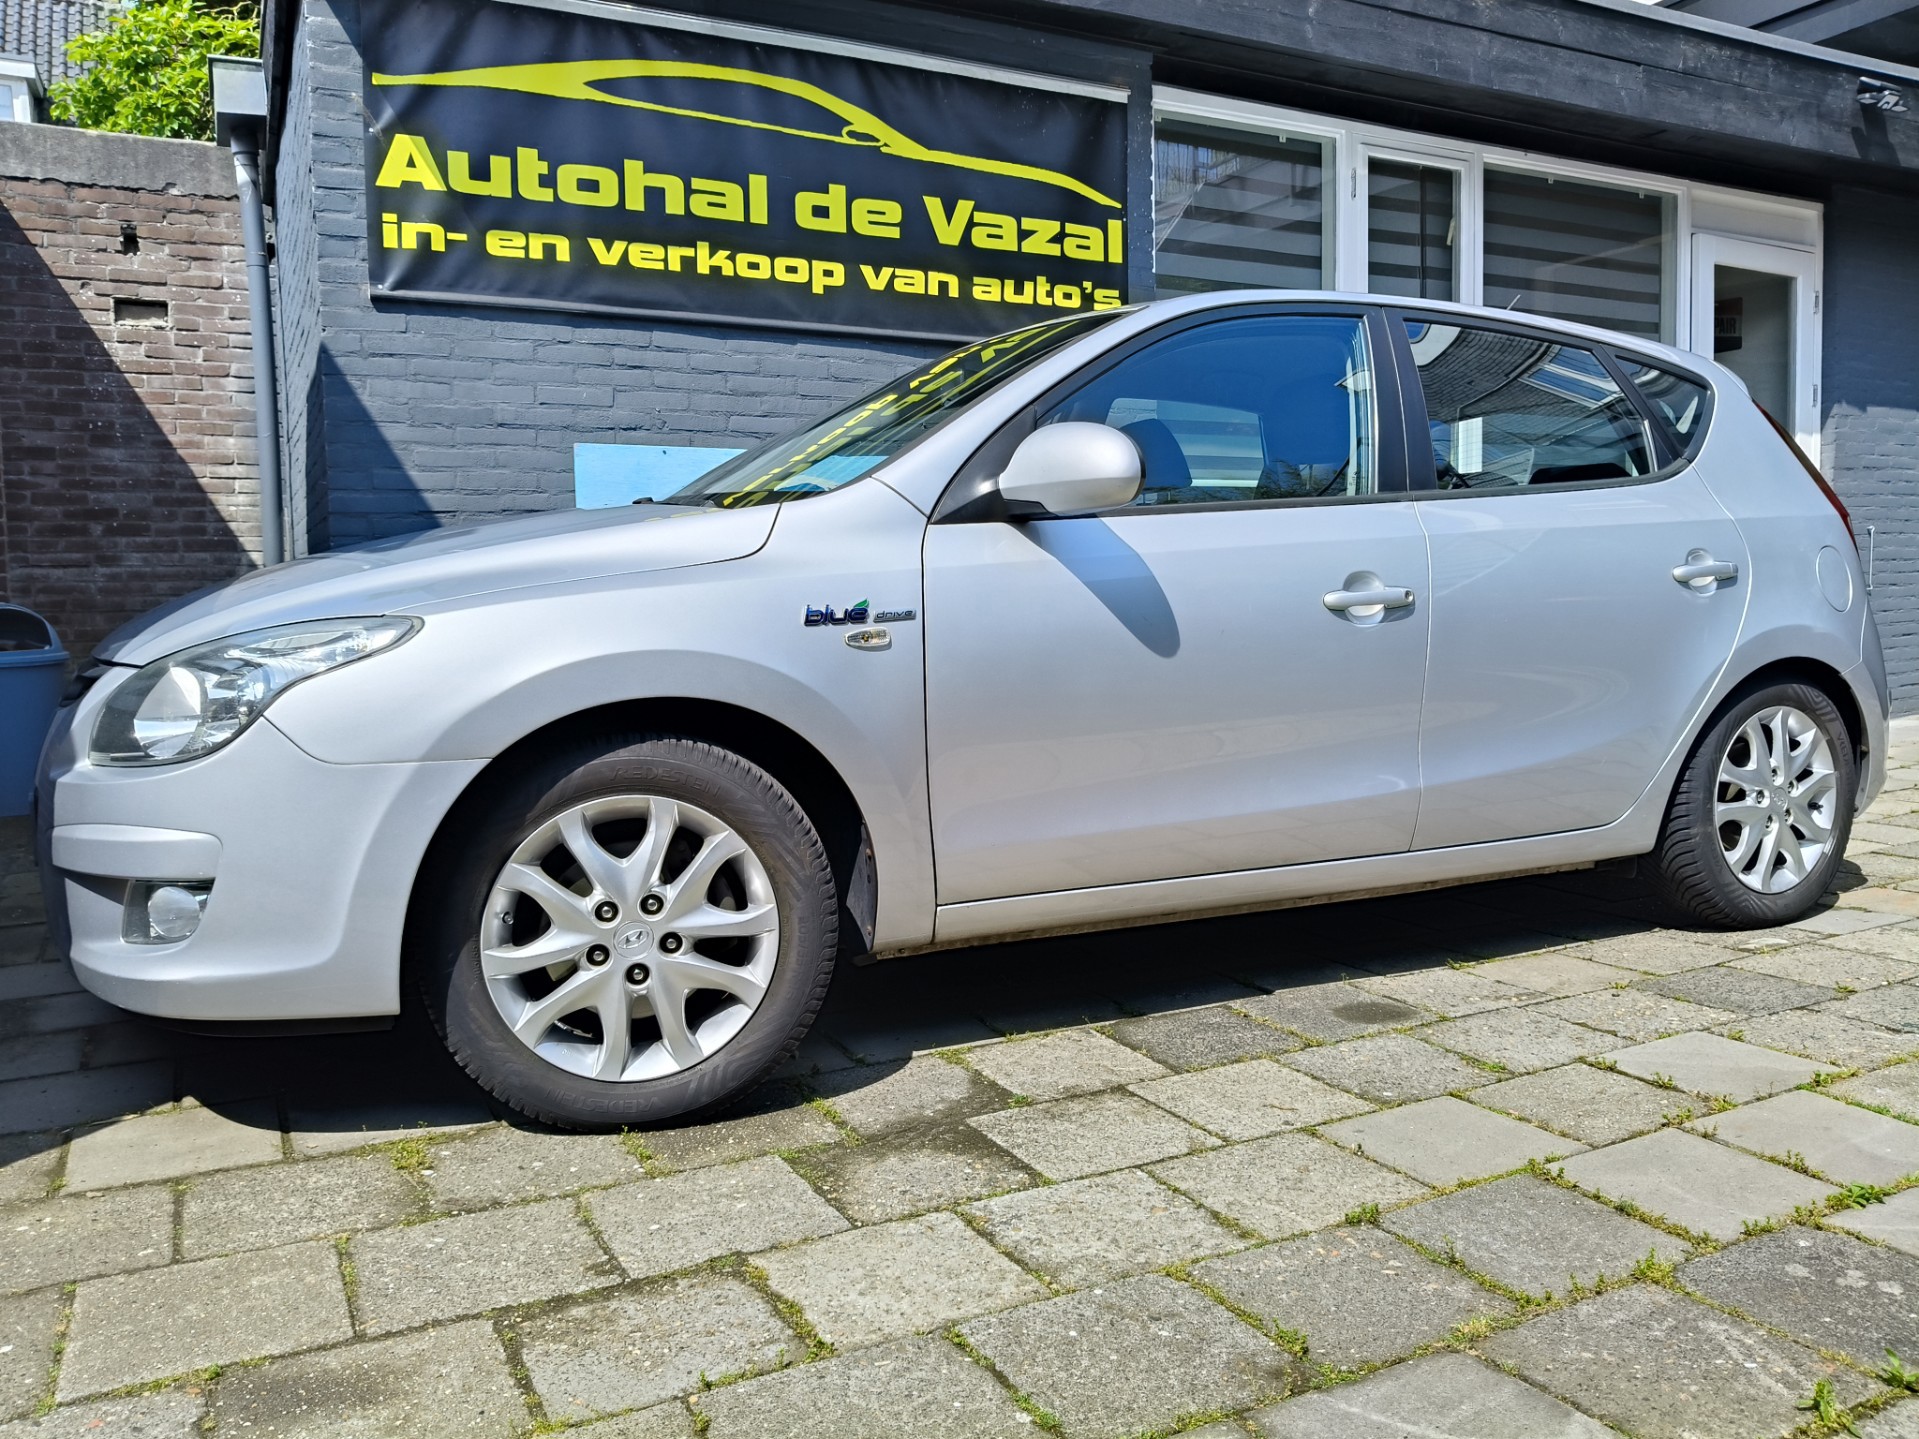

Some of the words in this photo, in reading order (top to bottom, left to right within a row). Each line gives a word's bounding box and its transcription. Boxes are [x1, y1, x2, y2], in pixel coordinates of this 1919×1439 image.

[376, 134, 769, 225] Autohal
[796, 184, 903, 239] de
[923, 195, 1123, 264] Vazal
[381, 212, 469, 253] in-
[486, 229, 571, 263] en
[588, 239, 846, 295] verkoop
[859, 264, 960, 298] van
[972, 276, 1122, 311] auto's
[804, 604, 869, 627] blue
[875, 609, 914, 621] drive
